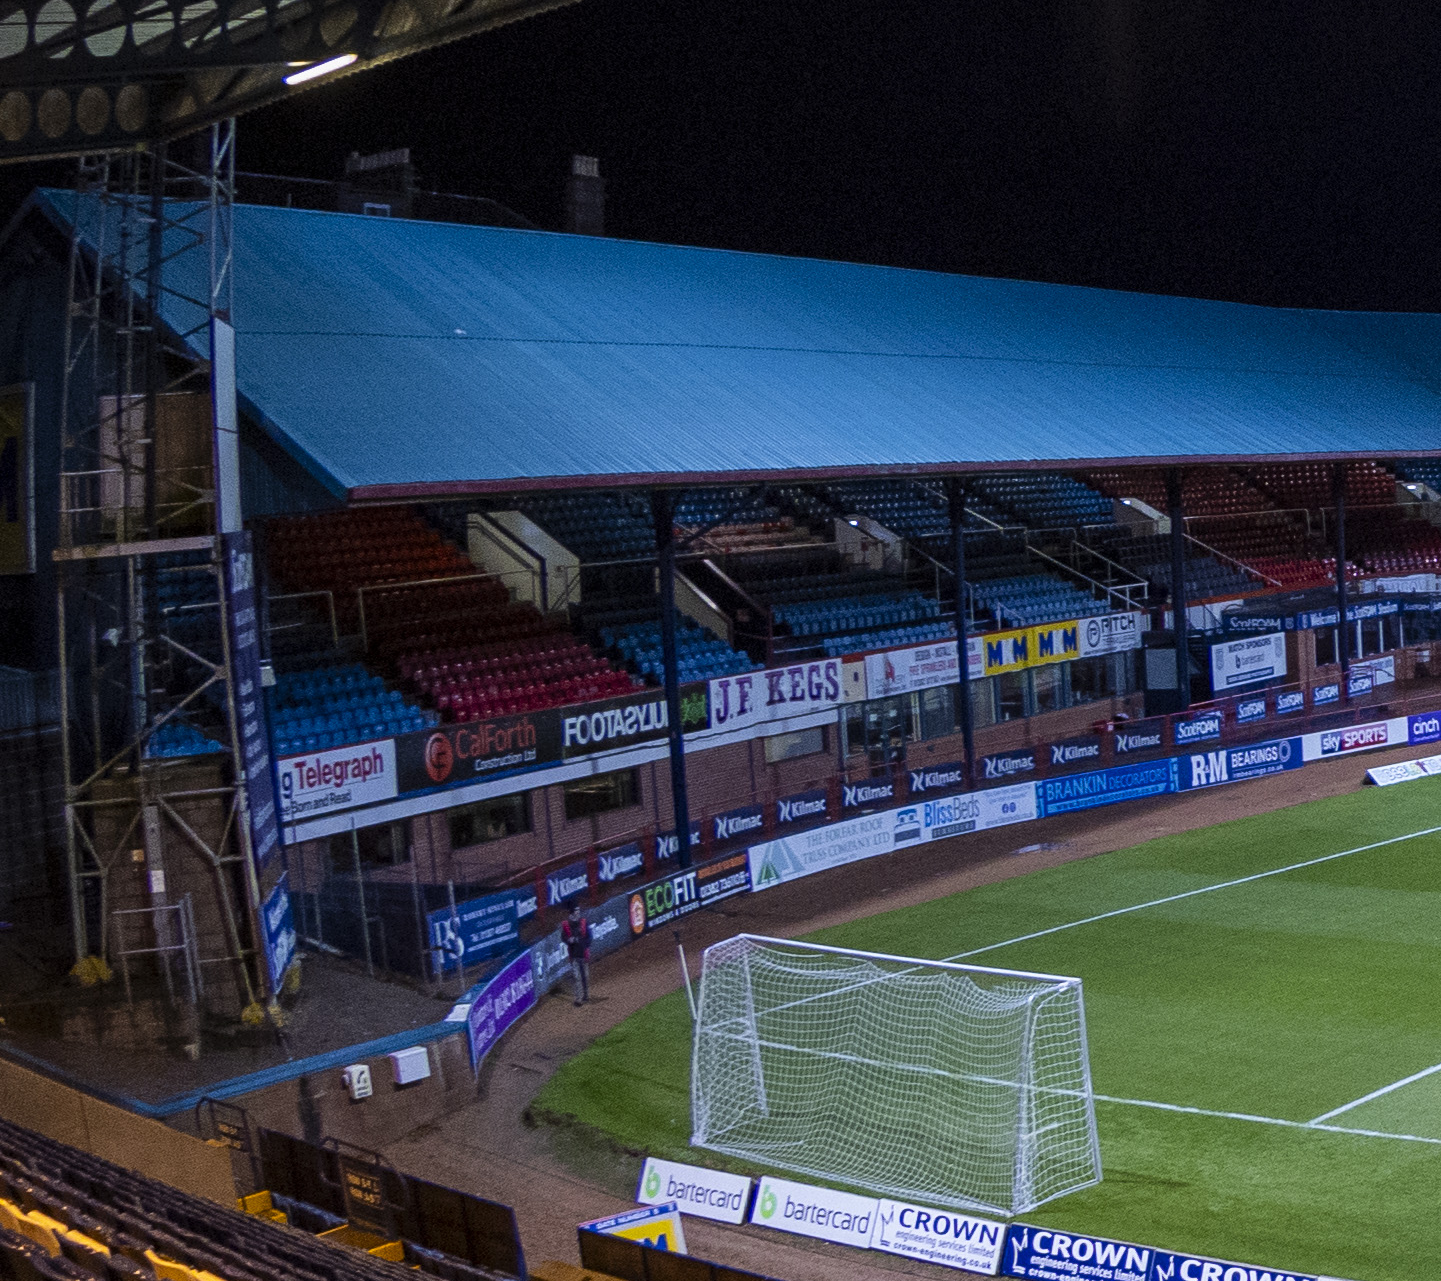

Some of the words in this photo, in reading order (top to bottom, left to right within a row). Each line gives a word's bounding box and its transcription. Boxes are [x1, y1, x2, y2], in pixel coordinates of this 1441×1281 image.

[1101, 613, 1135, 634] PITCH
[765, 660, 840, 707] KEGS
[455, 717, 537, 759] CalForth
[1178, 719, 1219, 738] ScotFOAM
[1321, 732, 1342, 753] sky
[1343, 723, 1388, 748] SPORTS
[1413, 716, 1440, 736] cinch
[1065, 743, 1098, 761] Kilmac
[1127, 733, 1161, 750] Kilmac
[294, 748, 384, 790] Telegraph
[474, 751, 522, 771] Construction
[523, 747, 537, 762] Ltd
[997, 754, 1034, 774] Kilmac
[1232, 745, 1279, 769] BEARINGS
[924, 769, 962, 788] Kilmac
[1047, 773, 1108, 802] BRANKIN
[1108, 766, 1167, 789] DECORATORS
[856, 784, 893, 804] Kilmac
[791, 798, 826, 818] Kilmac
[728, 813, 762, 834] Kilmac
[645, 871, 697, 919] ECOFIT
[666, 1175, 743, 1212] bartercard
[783, 1194, 871, 1235] bartercard
[899, 1206, 999, 1247] CROWN
[893, 1241, 992, 1271] crown-engineering.co.uk
[894, 1230, 938, 1251] engineering
[938, 1237, 968, 1257] services
[970, 1242, 995, 1260] limited
[1032, 1230, 1150, 1273] CROWN
[1030, 1254, 1075, 1275] engineering
[1076, 1262, 1113, 1281] services
